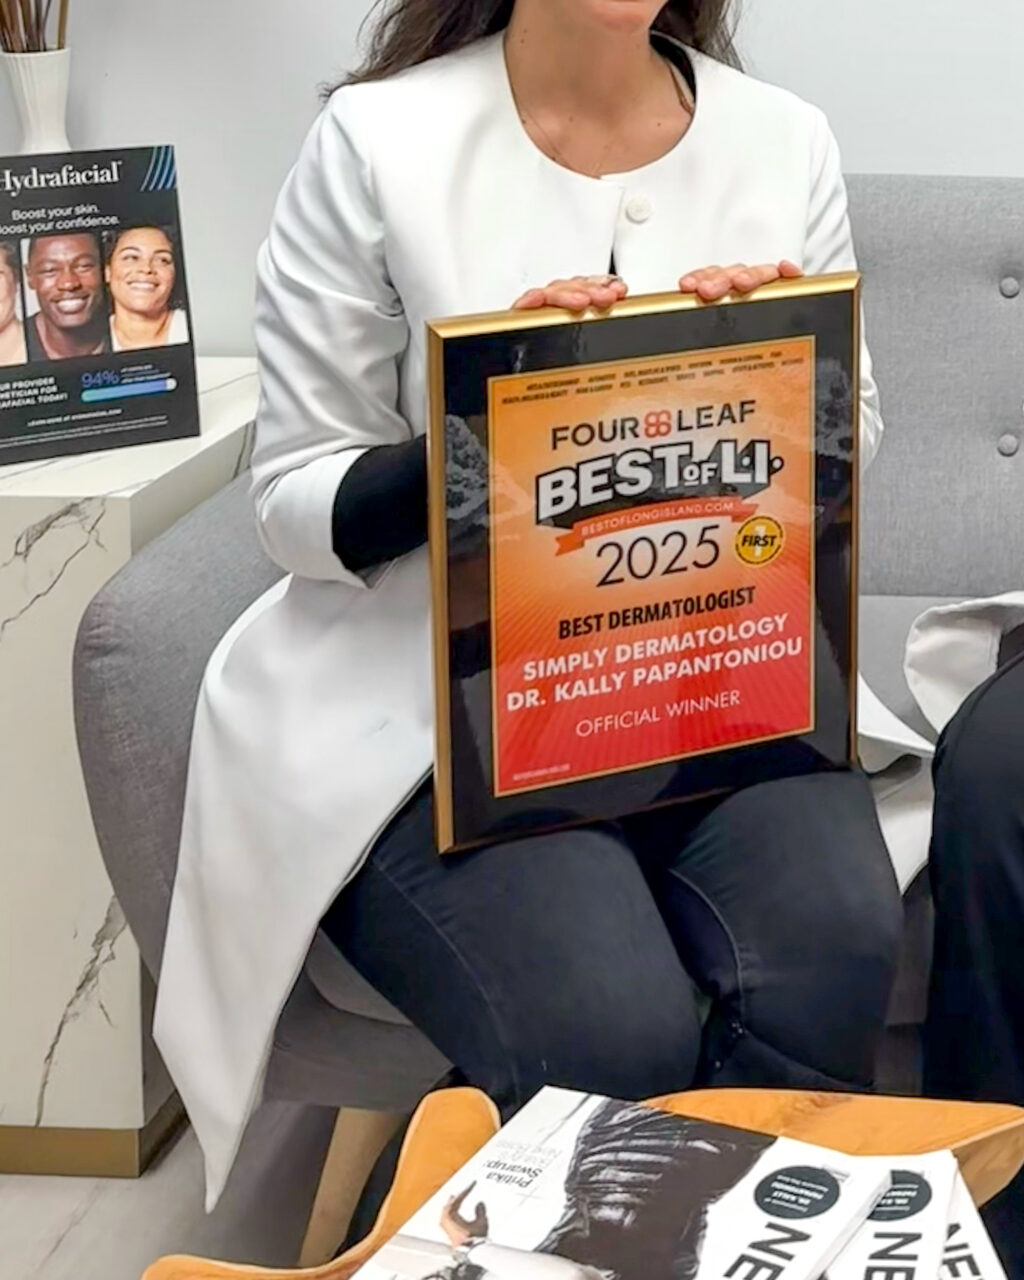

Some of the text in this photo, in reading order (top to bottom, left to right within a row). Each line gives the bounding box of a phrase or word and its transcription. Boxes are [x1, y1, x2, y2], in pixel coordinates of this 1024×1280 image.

[0, 215, 120, 235] oost your confidence.
[12, 203, 100, 221] Boost your skin.
[81, 370, 120, 388] 94%
[552, 399, 756, 450] FOUR LEAF
[537, 439, 770, 520] BEST OF LI
[581, 502, 734, 537] BESTOFLONGISLAND.COM
[741, 534, 778, 548] FIRST
[596, 525, 720, 588] 2025
[558, 586, 757, 640] BEST DERMATOLOGIST
[523, 613, 789, 682] SIMPLY DERMATOLOGY
[506, 636, 803, 712] DR. KALLY PAPANTONIOU
[575, 689, 742, 738] OFFICIAL WINNER
[486, 1172, 534, 1188] Pritika
